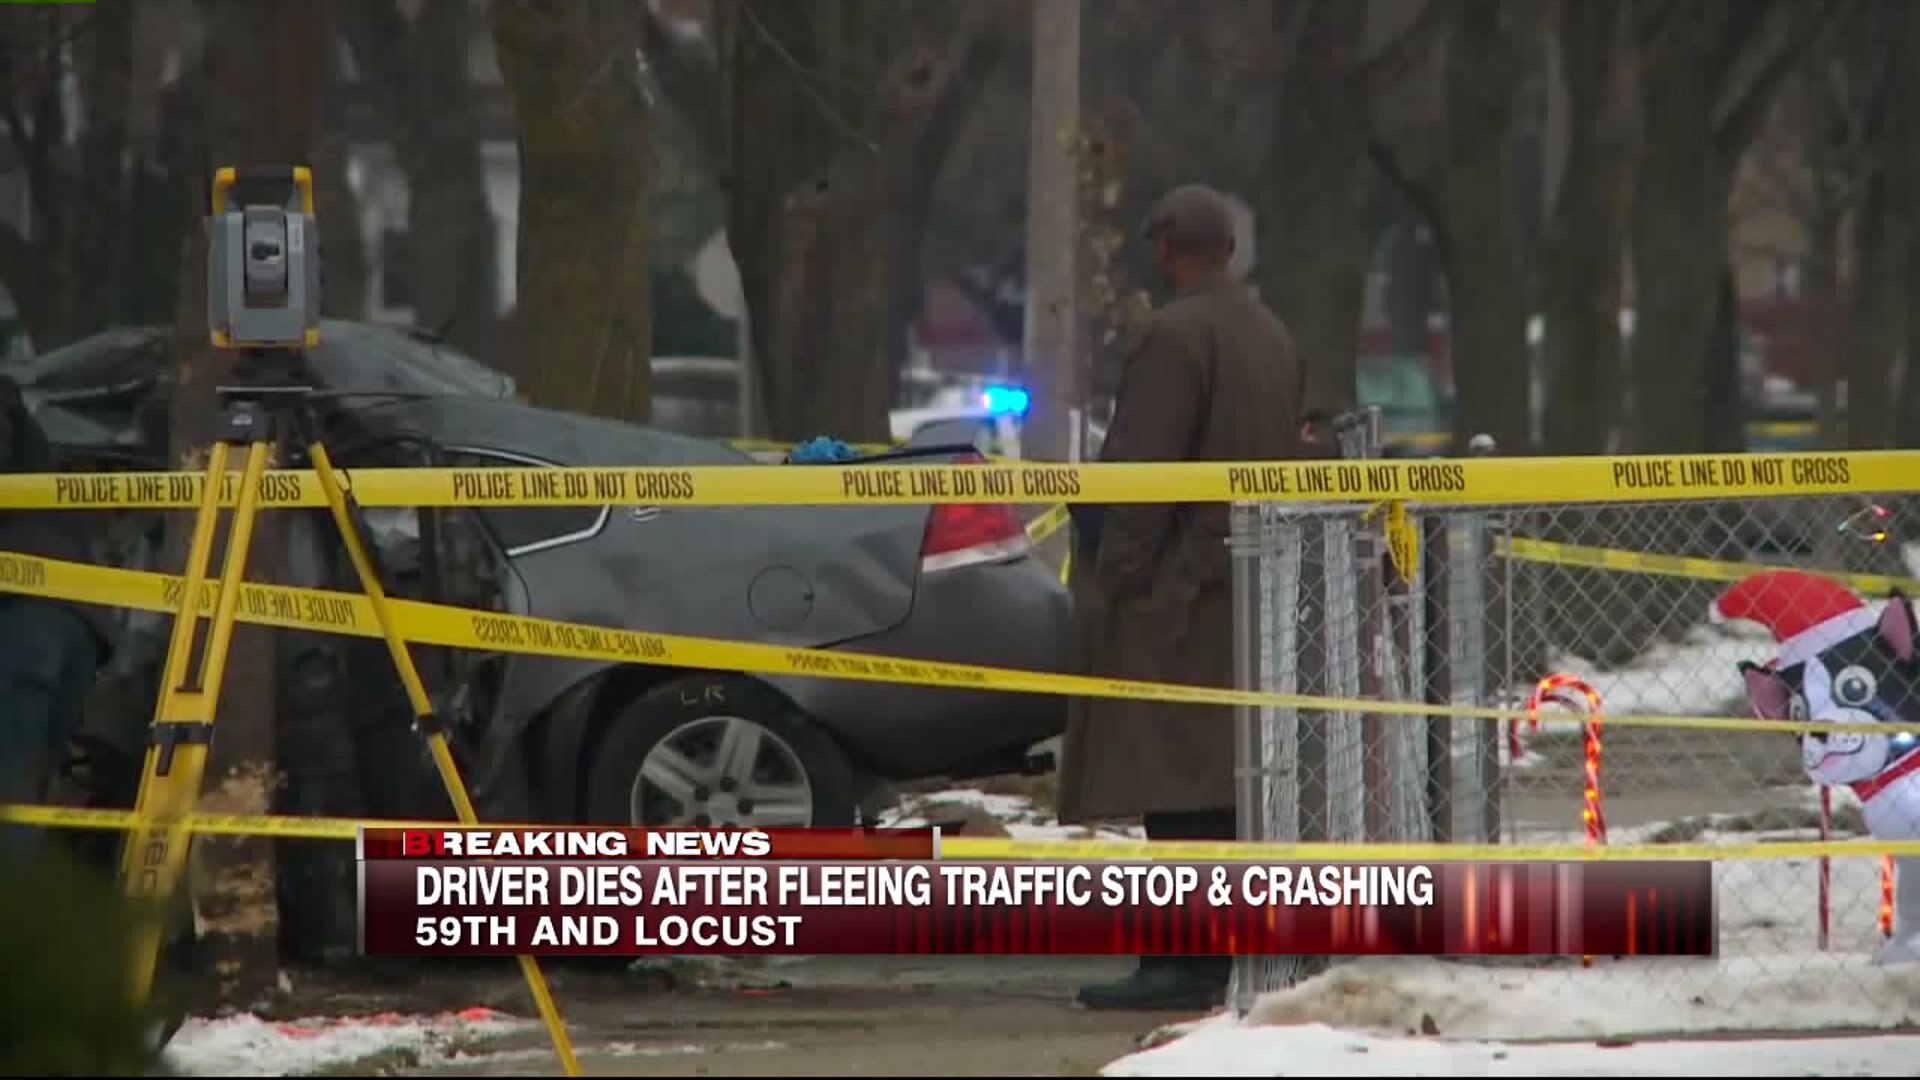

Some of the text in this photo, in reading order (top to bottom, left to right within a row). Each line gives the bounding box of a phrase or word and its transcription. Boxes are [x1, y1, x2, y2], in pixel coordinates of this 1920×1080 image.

[453, 471, 694, 500] POLICE LINE DO NOT CROSS
[842, 468, 1081, 497] POLICE LINE DO NOT CROSS
[1228, 464, 1465, 494] POLICE LINE DO NOT CROSS
[1613, 457, 1850, 488] POLICE LINE DO NOT CROSS
[56, 476, 119, 502] POLICE
[126, 476, 165, 501] LINE
[170, 475, 193, 501] DO
